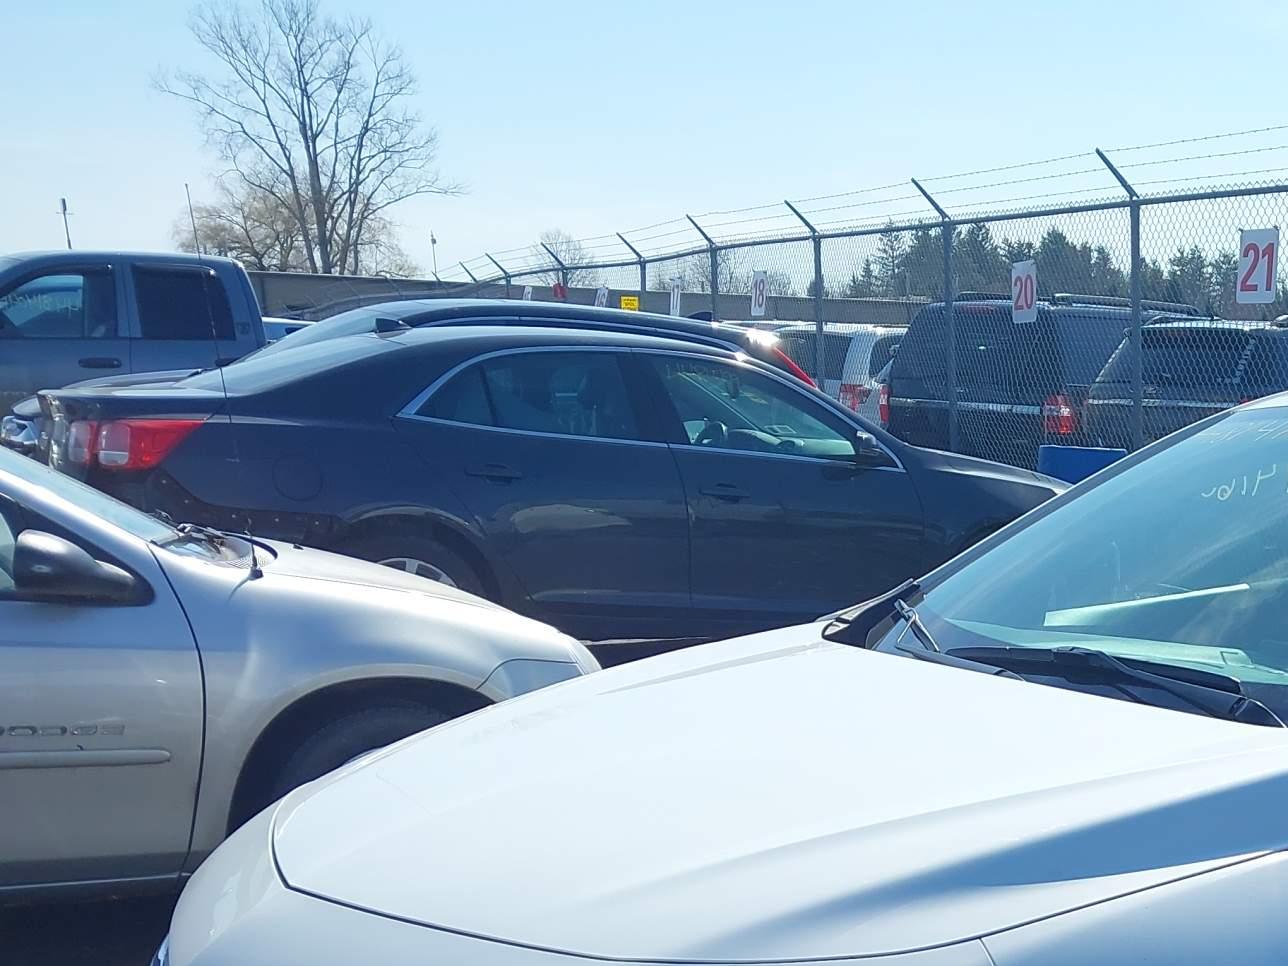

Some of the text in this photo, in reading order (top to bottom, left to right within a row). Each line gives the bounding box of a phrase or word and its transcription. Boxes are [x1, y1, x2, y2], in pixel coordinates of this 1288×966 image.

[1240, 242, 1275, 293] 21
[753, 278, 765, 308] 18
[1013, 275, 1034, 311] 20
[0, 724, 125, 736] ODGE
